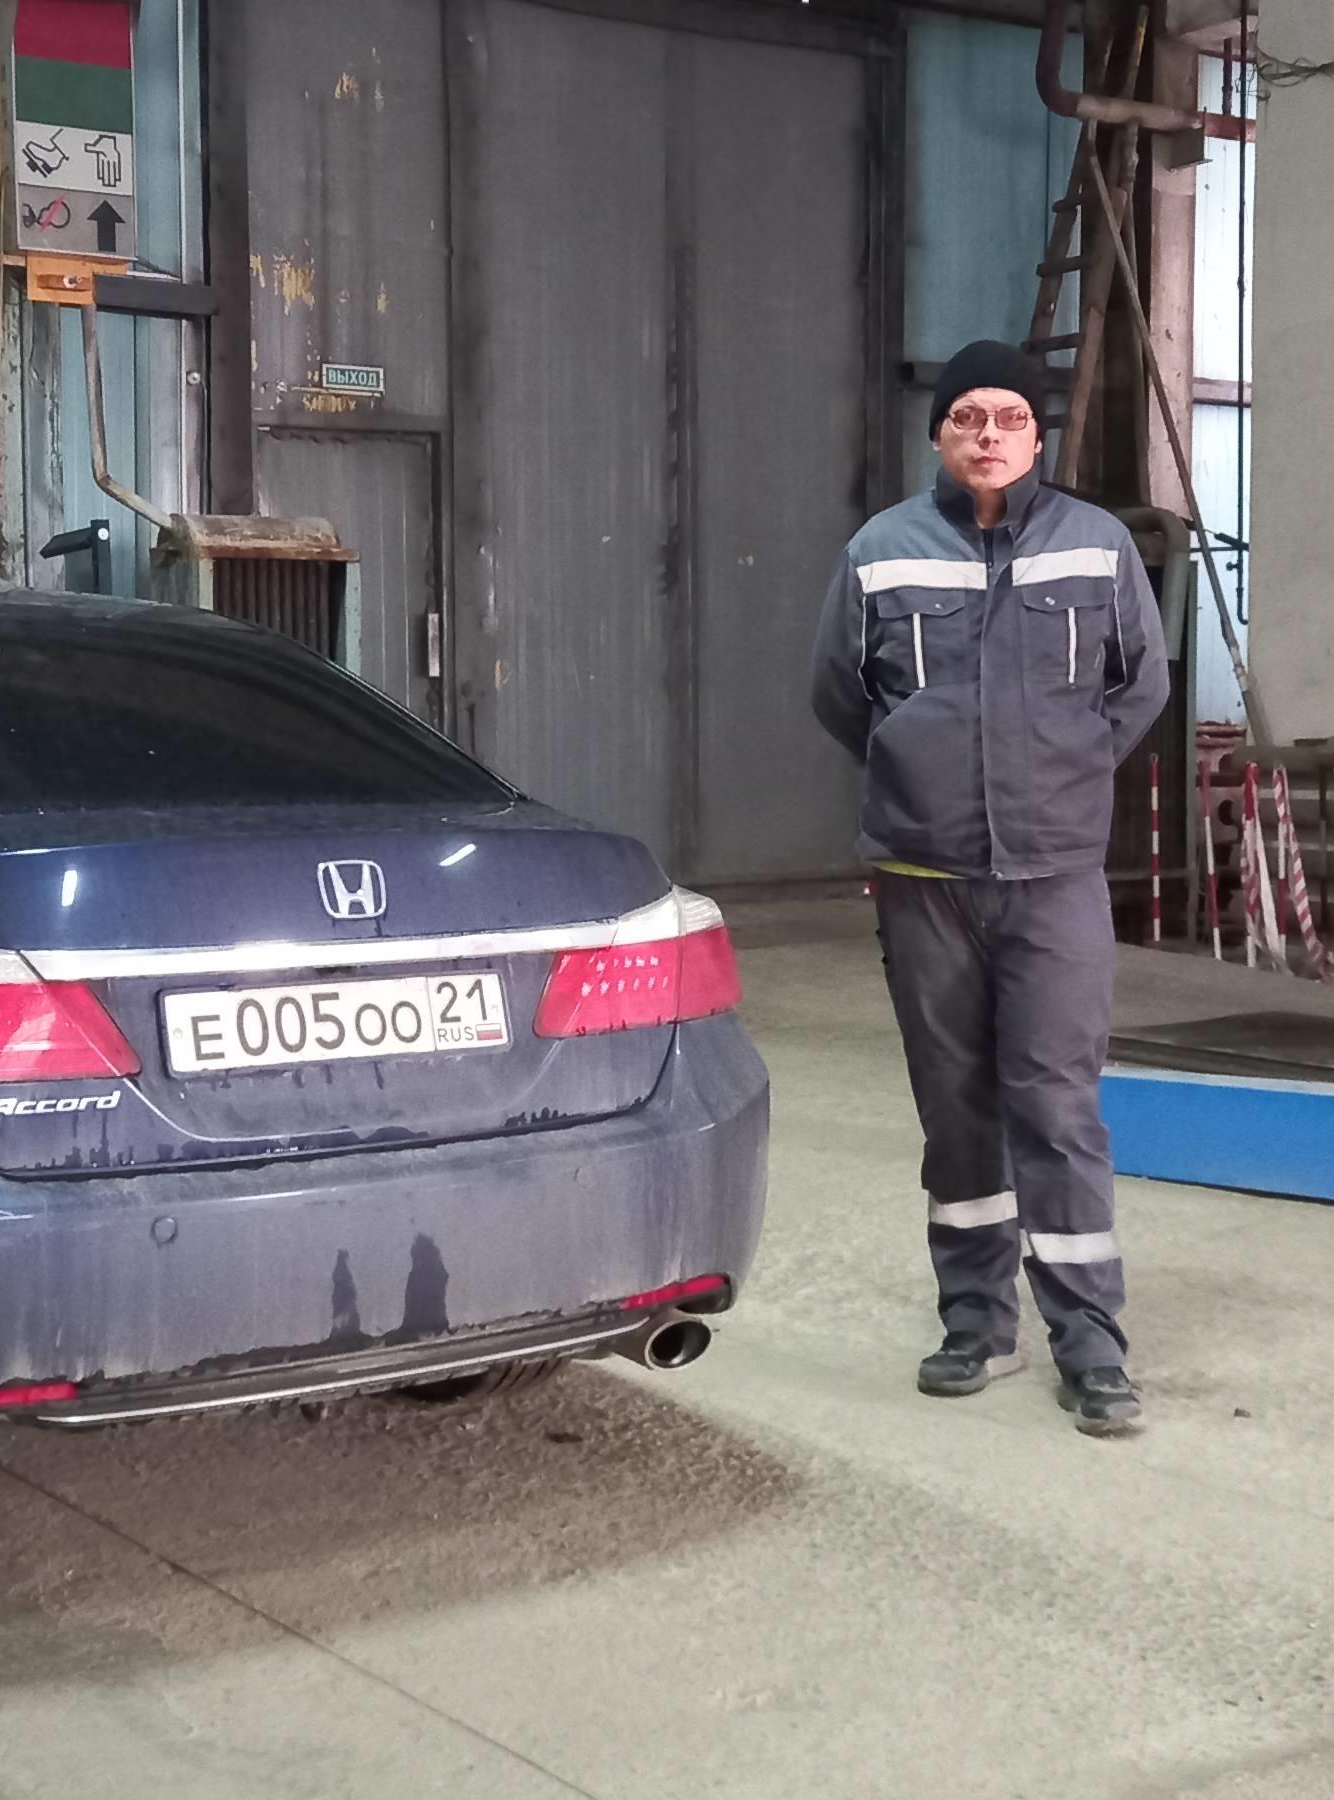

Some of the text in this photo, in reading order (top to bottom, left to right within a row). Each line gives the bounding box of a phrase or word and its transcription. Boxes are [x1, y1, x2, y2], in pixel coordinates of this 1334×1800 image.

[328, 369, 378, 386] ВЫХОД
[436, 978, 488, 1024] 21
[437, 1026, 474, 1043] RUS
